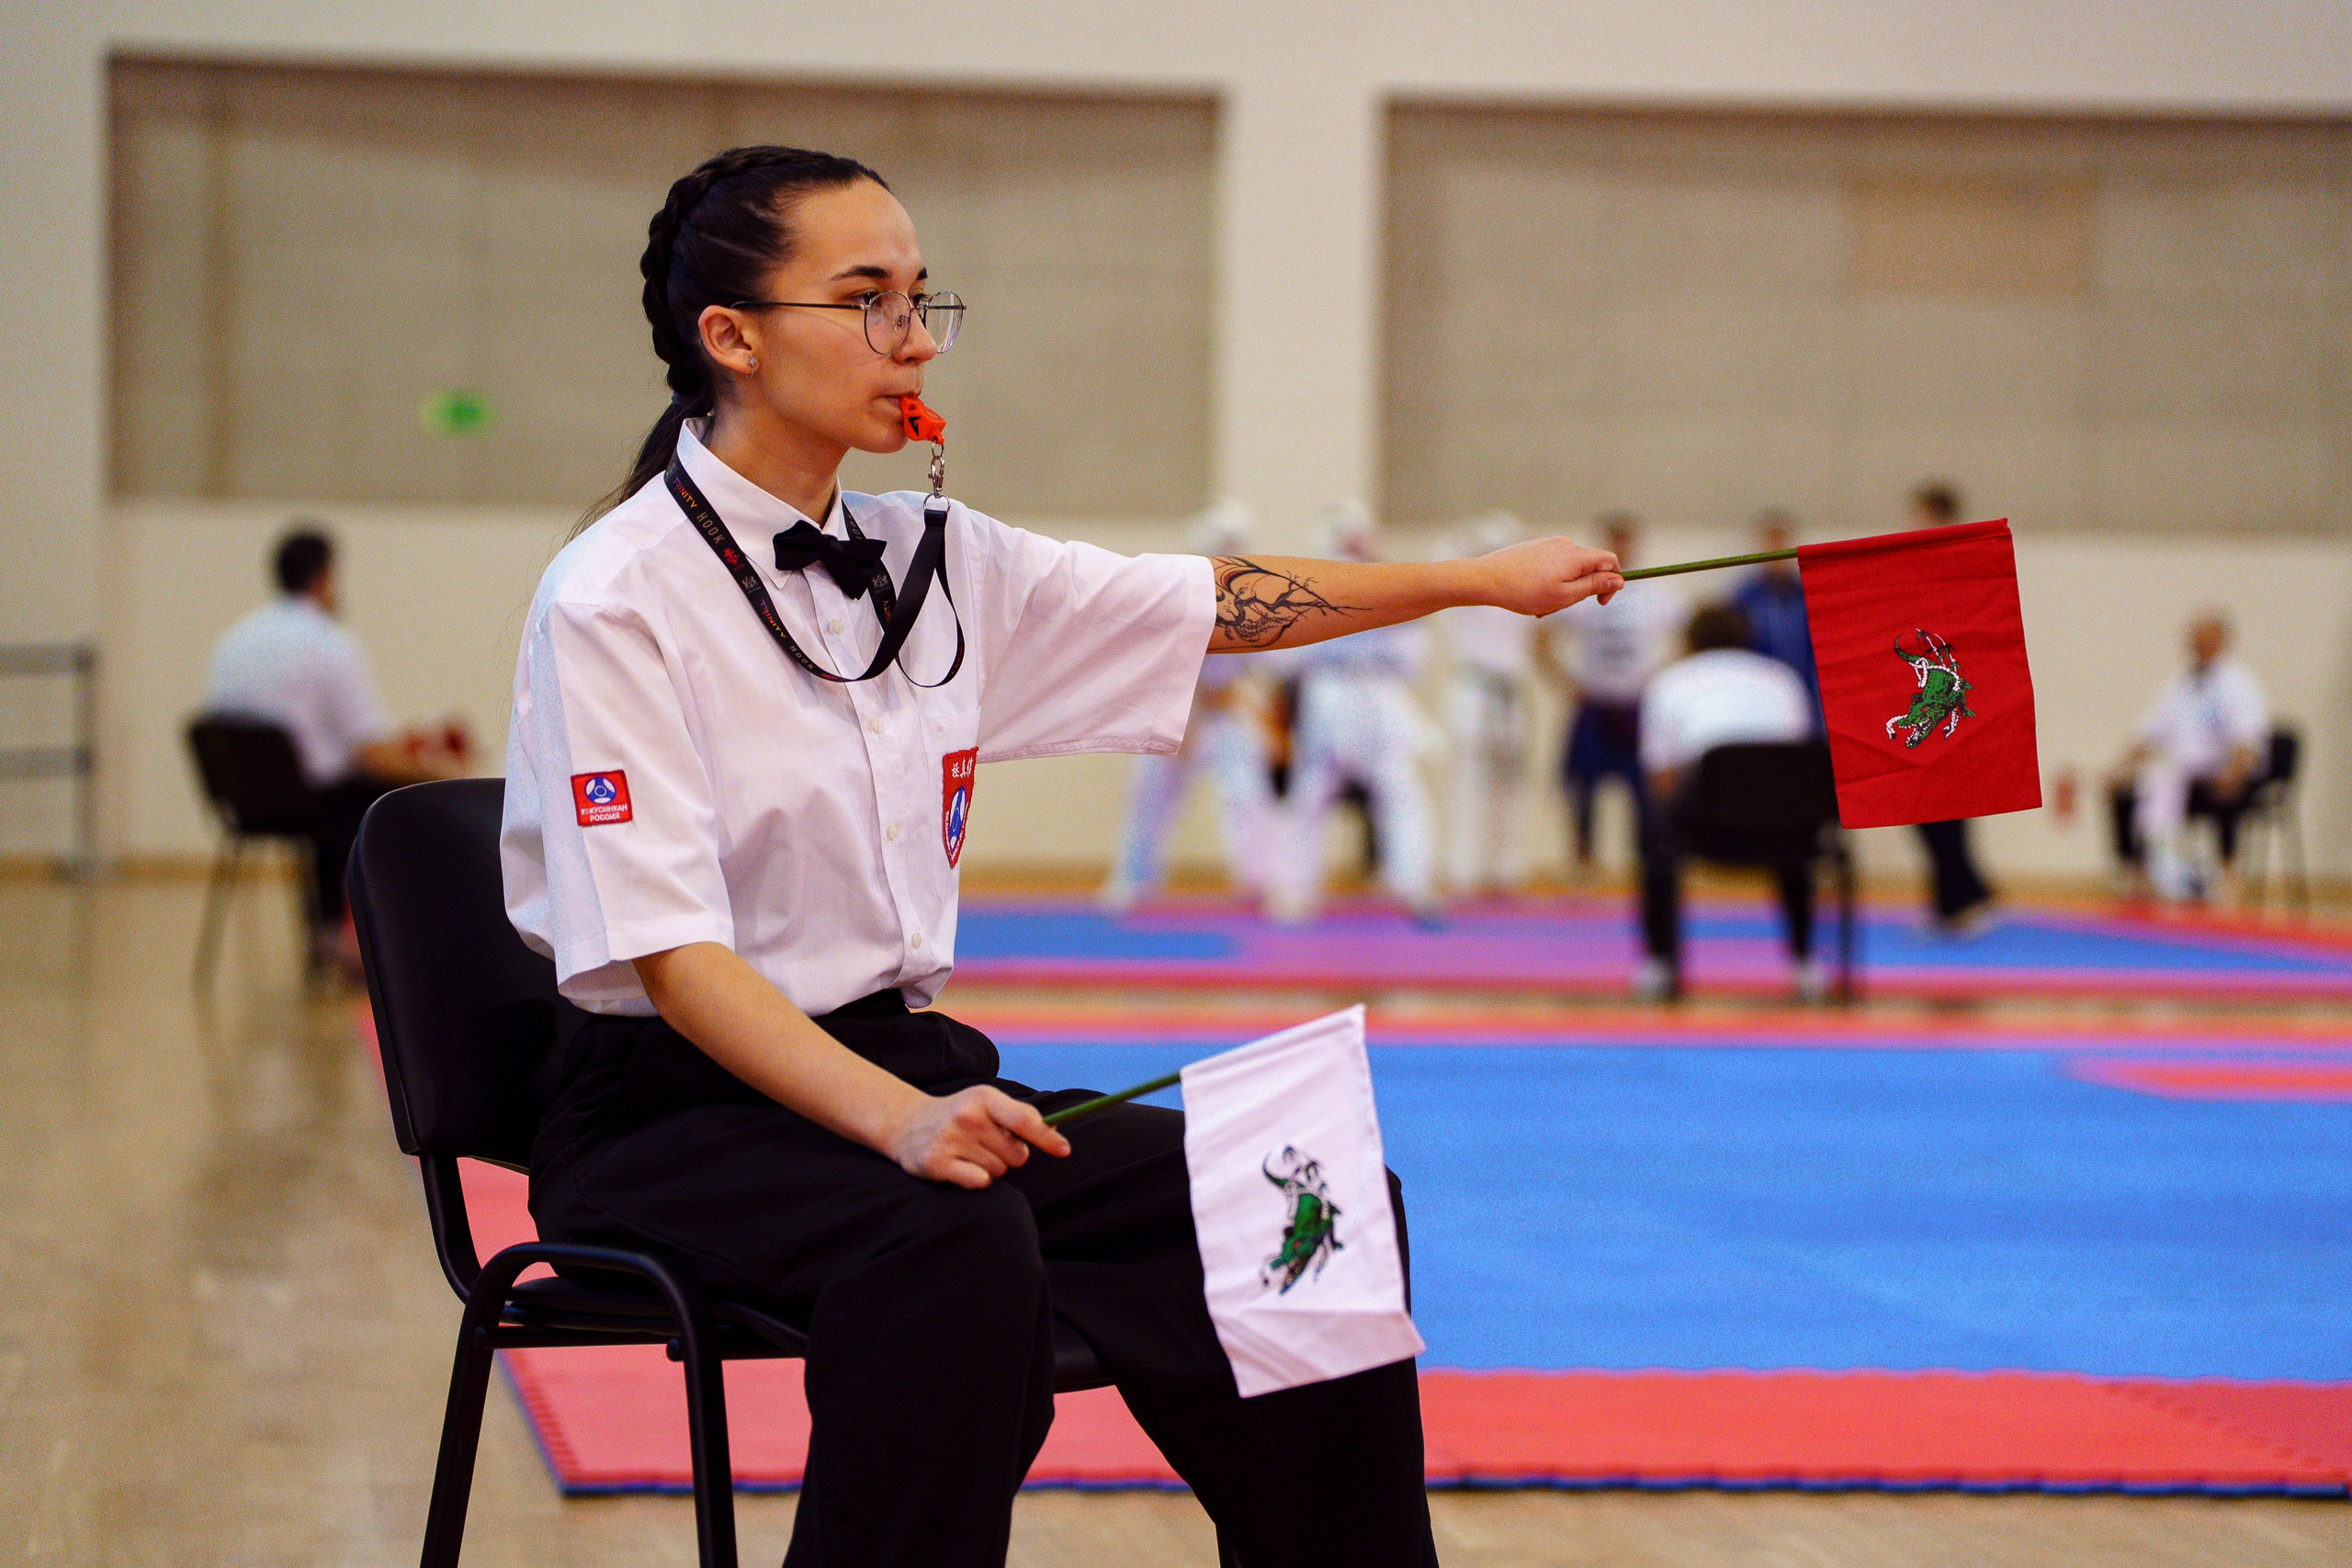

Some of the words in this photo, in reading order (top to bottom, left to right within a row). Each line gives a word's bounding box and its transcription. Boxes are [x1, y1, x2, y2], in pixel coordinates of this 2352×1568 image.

[695, 512, 725, 544] HOOK
[789, 645, 815, 670] HOOK
[589, 812, 621, 822] РОССИЯ
